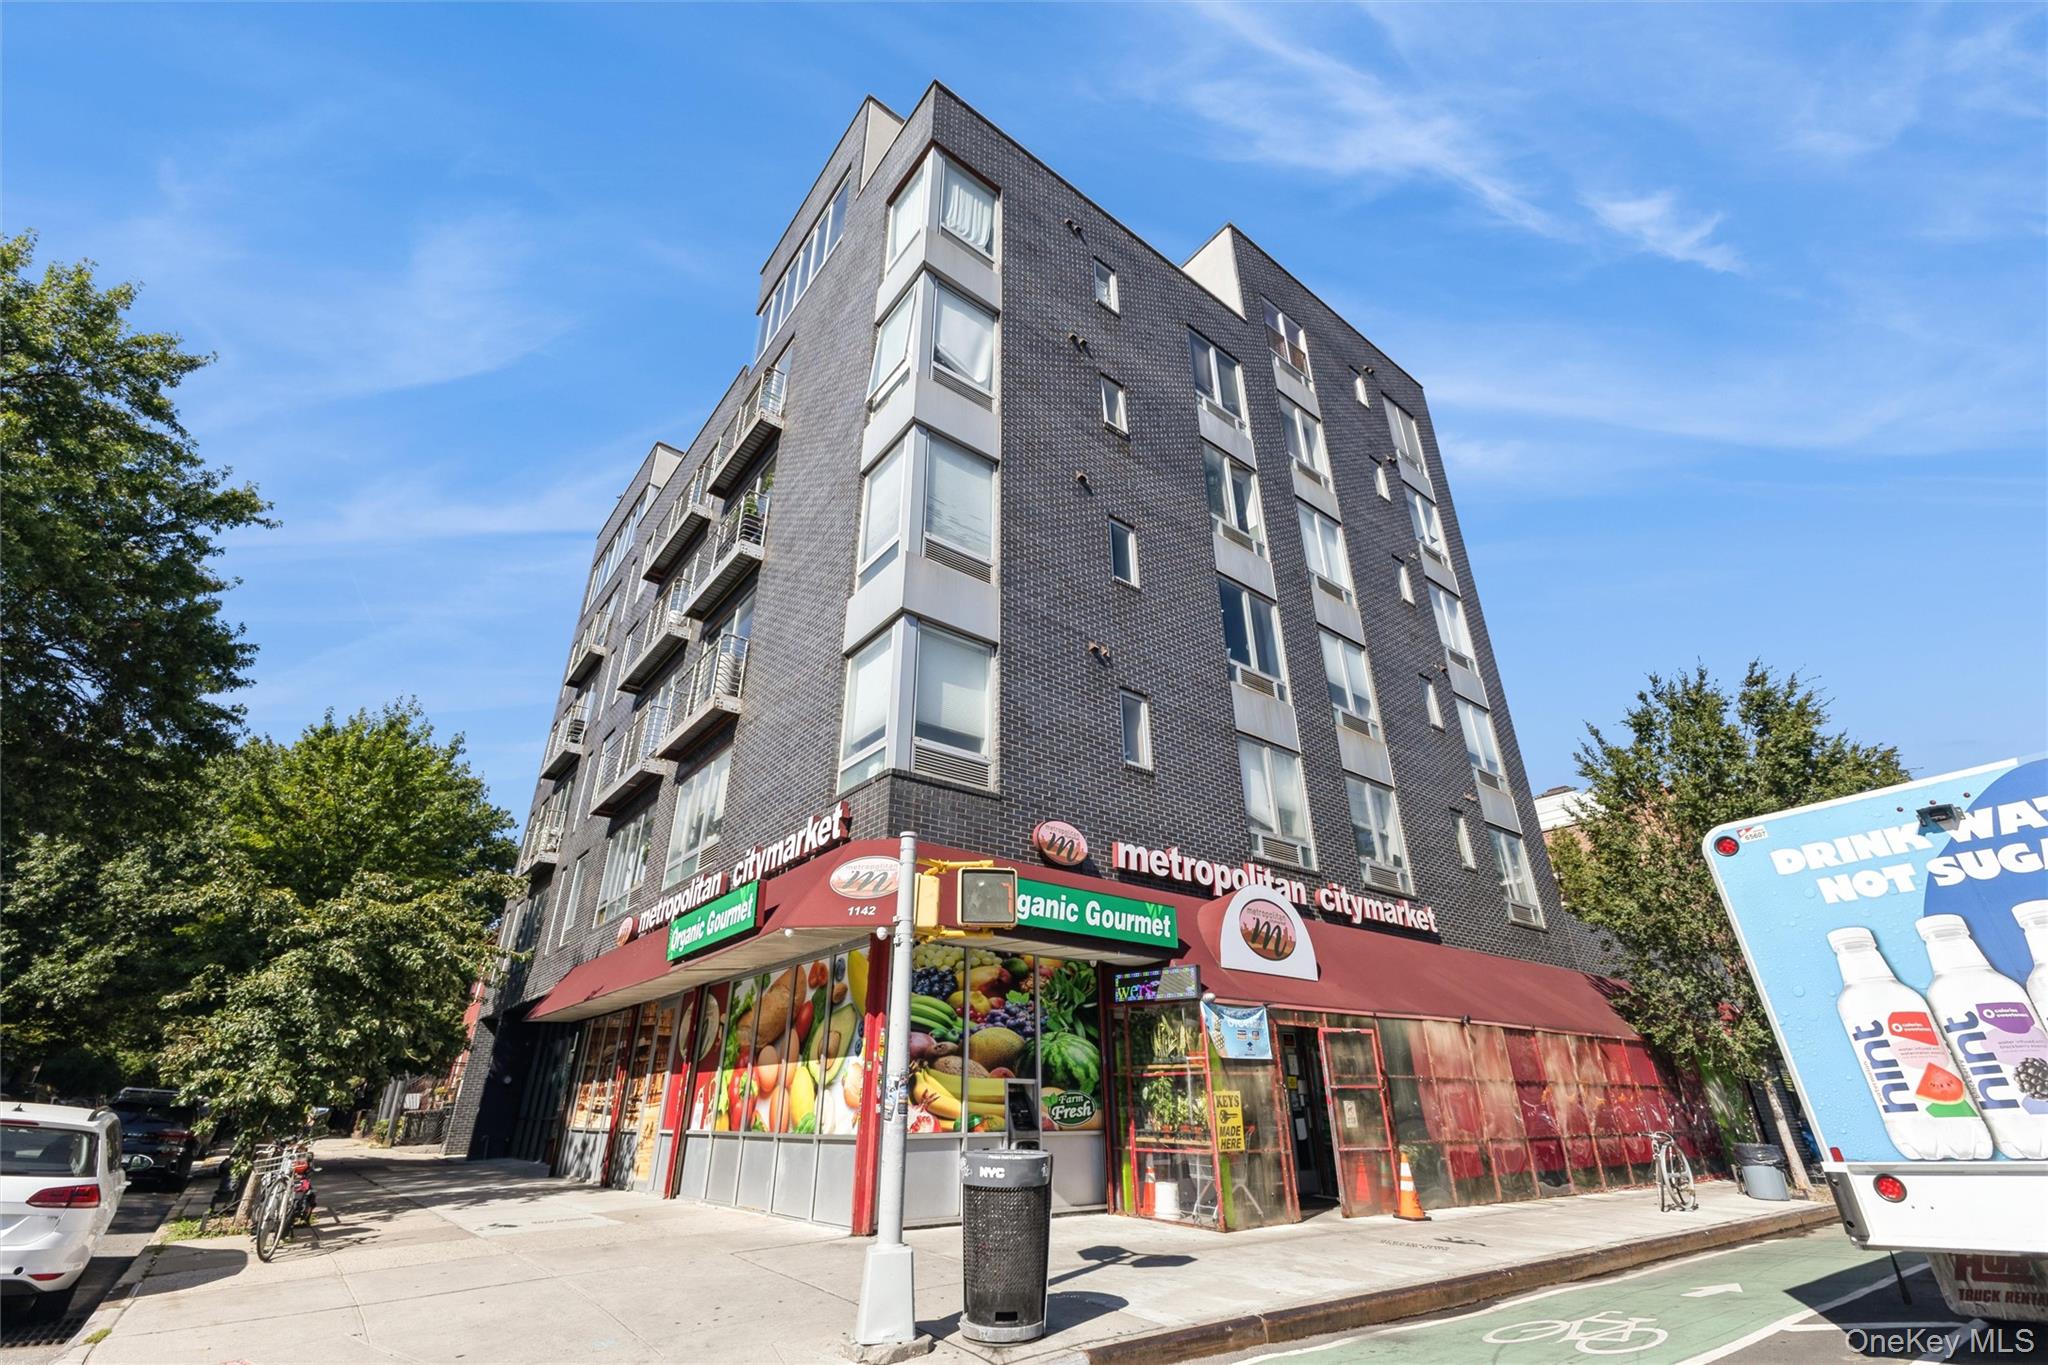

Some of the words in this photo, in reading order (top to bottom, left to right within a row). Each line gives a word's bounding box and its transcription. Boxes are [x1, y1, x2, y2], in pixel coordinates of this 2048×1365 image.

[1770, 821, 1934, 875] DRINK
[638, 870, 724, 934] metropolitan
[732, 801, 845, 888] citymarket
[1816, 863, 1917, 904] NOT
[1926, 838, 2048, 887] SUG
[1116, 842, 1307, 905] metropolitan
[1320, 882, 1439, 933] citymarket
[848, 905, 877, 916] 1142
[1016, 895, 1079, 922] ganic
[1085, 900, 1171, 938] Gourmet
[670, 917, 705, 951] Organic
[706, 893, 754, 936] Gourmet
[1059, 1095, 1084, 1105] Farm
[1216, 1094, 1240, 1108] KEYS
[1051, 1100, 1092, 1120] Fresh
[1220, 1125, 1242, 1137] MADE
[1220, 1137, 1242, 1150] HERE
[980, 1165, 1006, 1179] NYC
[1958, 1288, 2001, 1303] TRUCK
